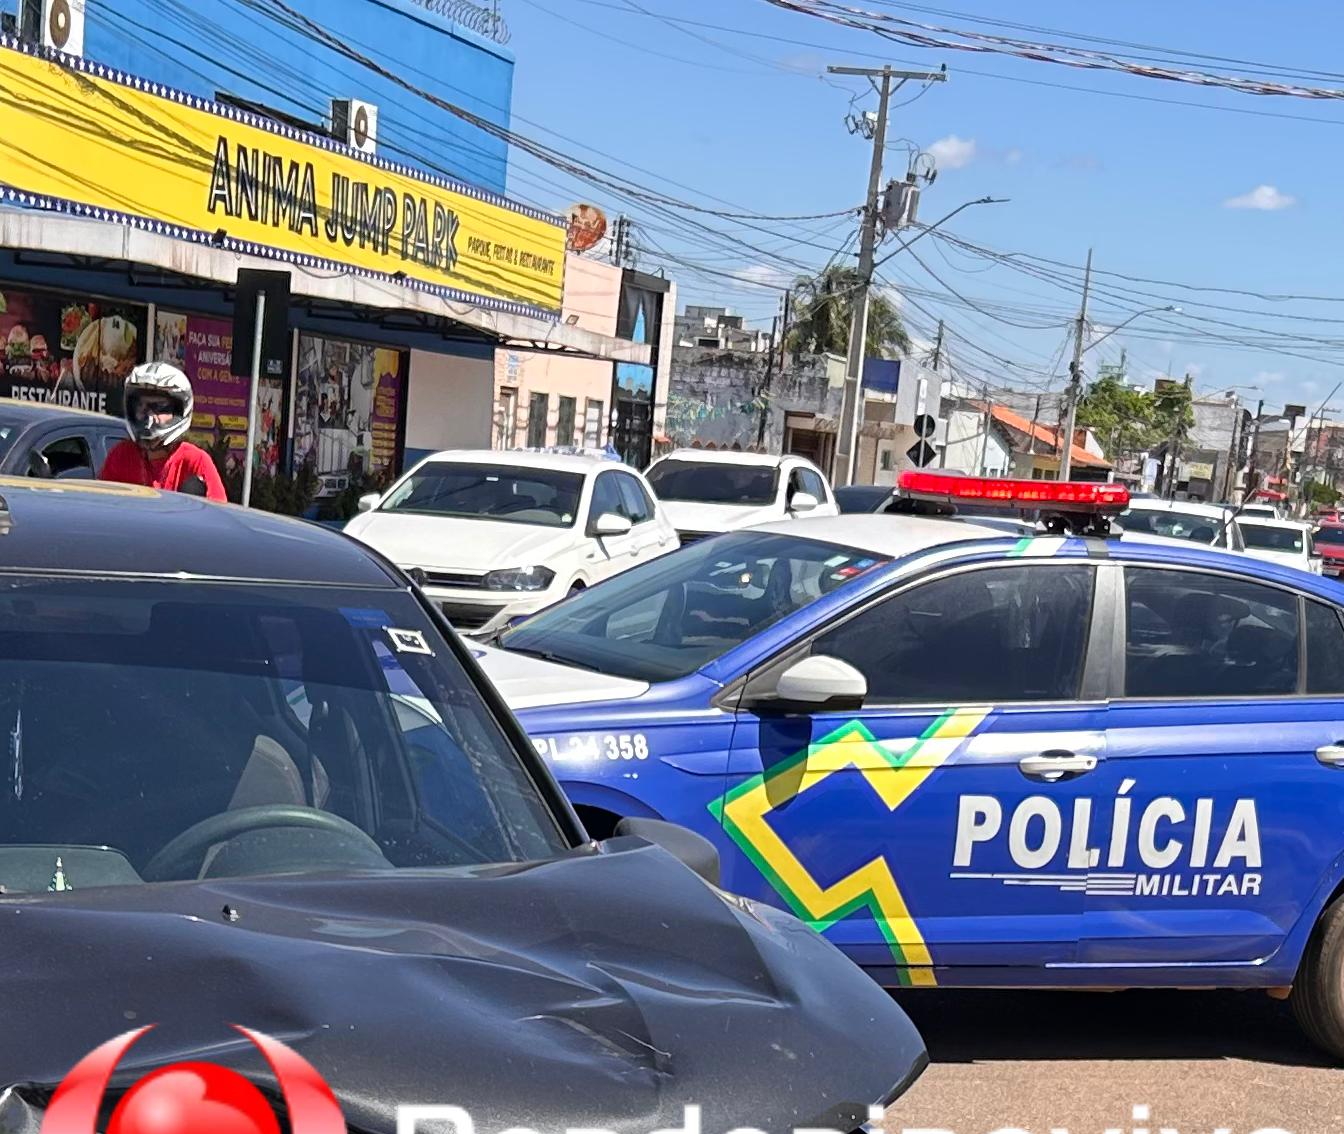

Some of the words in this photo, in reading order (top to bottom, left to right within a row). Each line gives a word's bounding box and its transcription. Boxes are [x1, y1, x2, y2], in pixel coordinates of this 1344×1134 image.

[207, 136, 319, 238] ANIMA
[325, 171, 398, 256] JUMP
[401, 191, 460, 272] PARK
[604, 733, 649, 760] 358
[953, 778, 1262, 868] POLÍCIA
[1135, 874, 1262, 896] MILITAR
